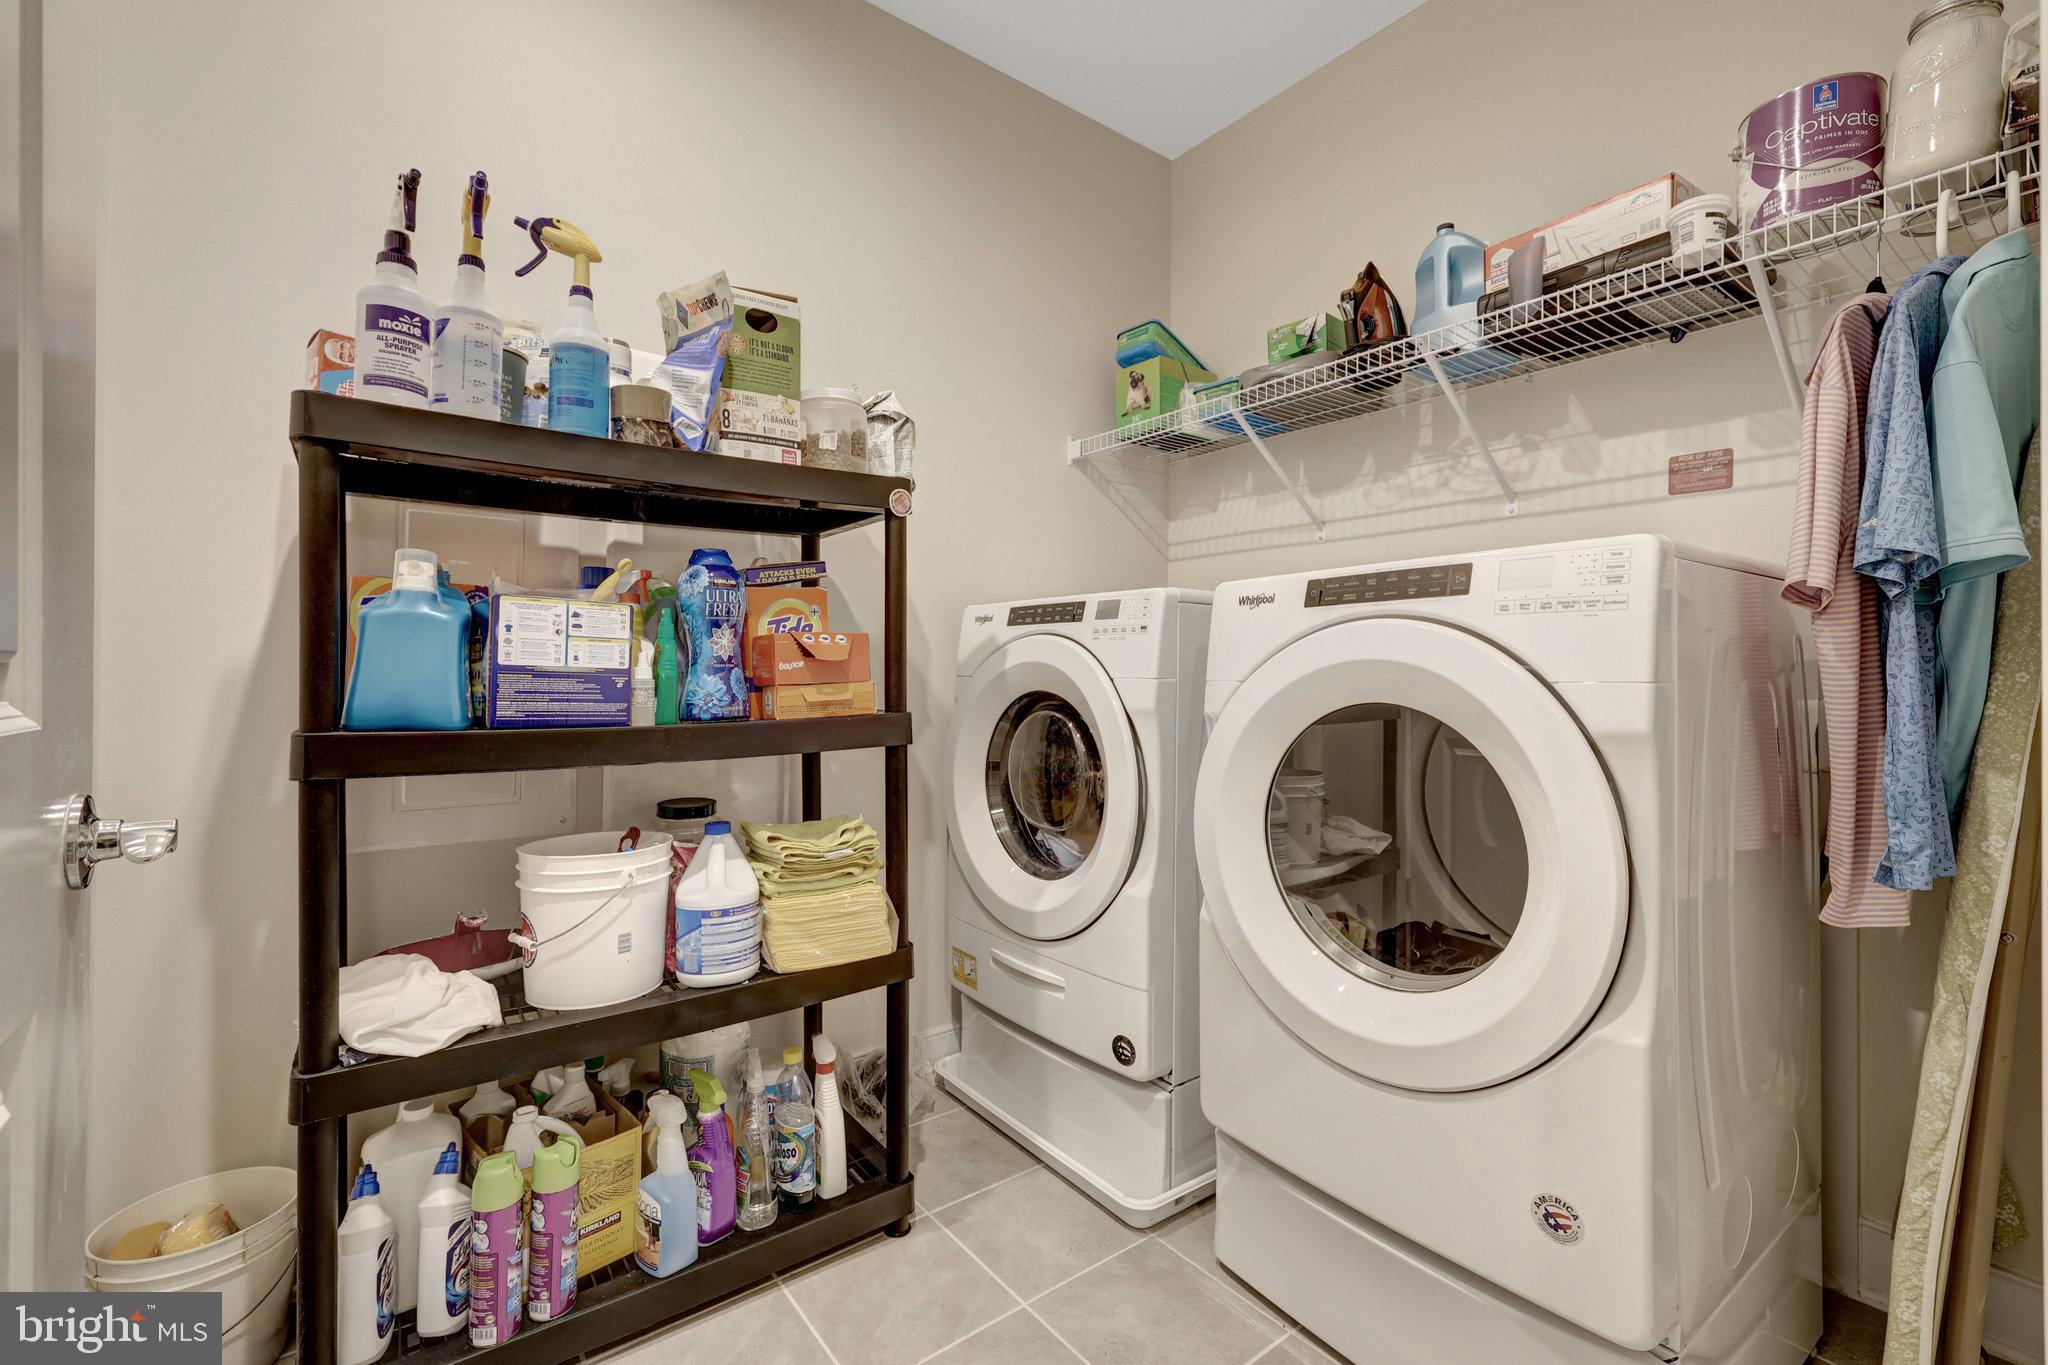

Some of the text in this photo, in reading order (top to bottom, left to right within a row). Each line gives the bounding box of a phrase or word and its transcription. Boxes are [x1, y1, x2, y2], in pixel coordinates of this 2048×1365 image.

[1765, 109, 1879, 149] Captivate
[1814, 131, 1842, 142] PRIMER
[378, 317, 423, 337] moxie
[376, 334, 424, 352] ALL-PURPOSE
[384, 341, 418, 355] SPRAYER
[722, 408, 731, 429] 8
[759, 566, 817, 579] ATTACKS EVEN
[705, 589, 742, 603] ULTRA
[1239, 593, 1276, 610] Whirlpool
[766, 615, 814, 634] Tide
[1533, 1195, 1580, 1222] AMERICA
[580, 1212, 621, 1236] KIRKLAND
[577, 1226, 625, 1251] HARDONNAY
